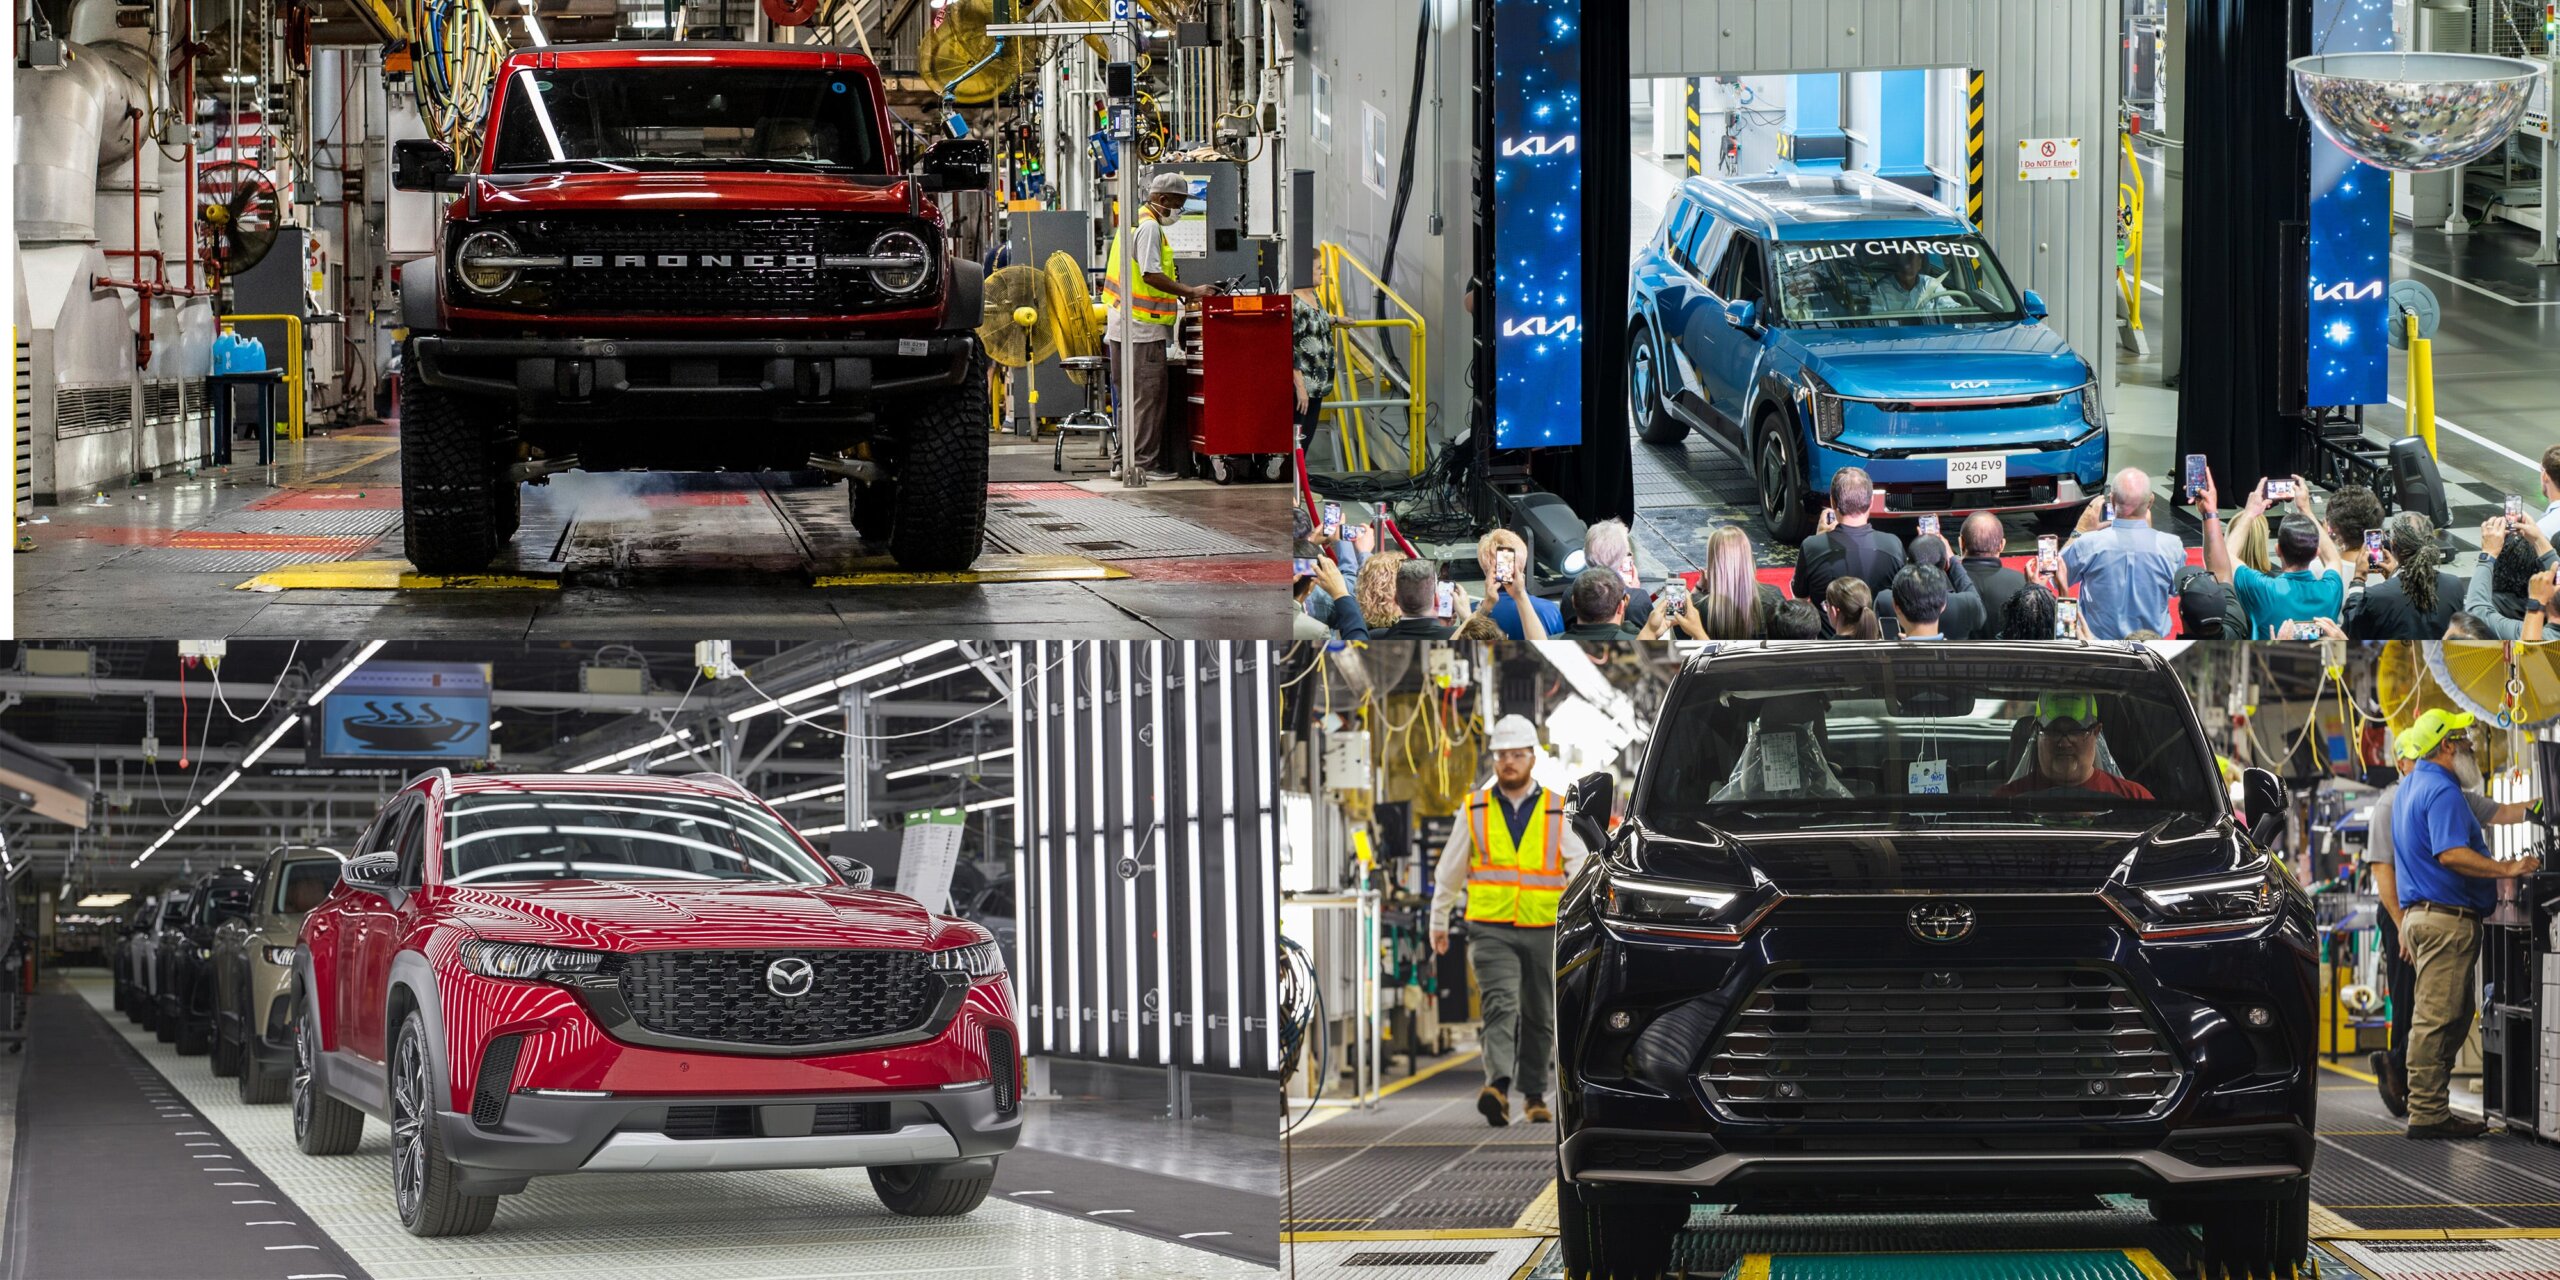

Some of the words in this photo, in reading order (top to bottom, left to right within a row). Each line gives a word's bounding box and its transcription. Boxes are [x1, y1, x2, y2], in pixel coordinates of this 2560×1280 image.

[2024, 160, 2035, 168] Do
[1784, 243, 1856, 267] FULLY
[1864, 240, 1980, 258] CHARGED
[572, 255, 817, 267] BRONCO
[2313, 281, 2382, 300] KIA
[1951, 461, 1978, 472] 2024
[1981, 460, 2002, 470] EV9
[1965, 473, 1988, 484] SOP
